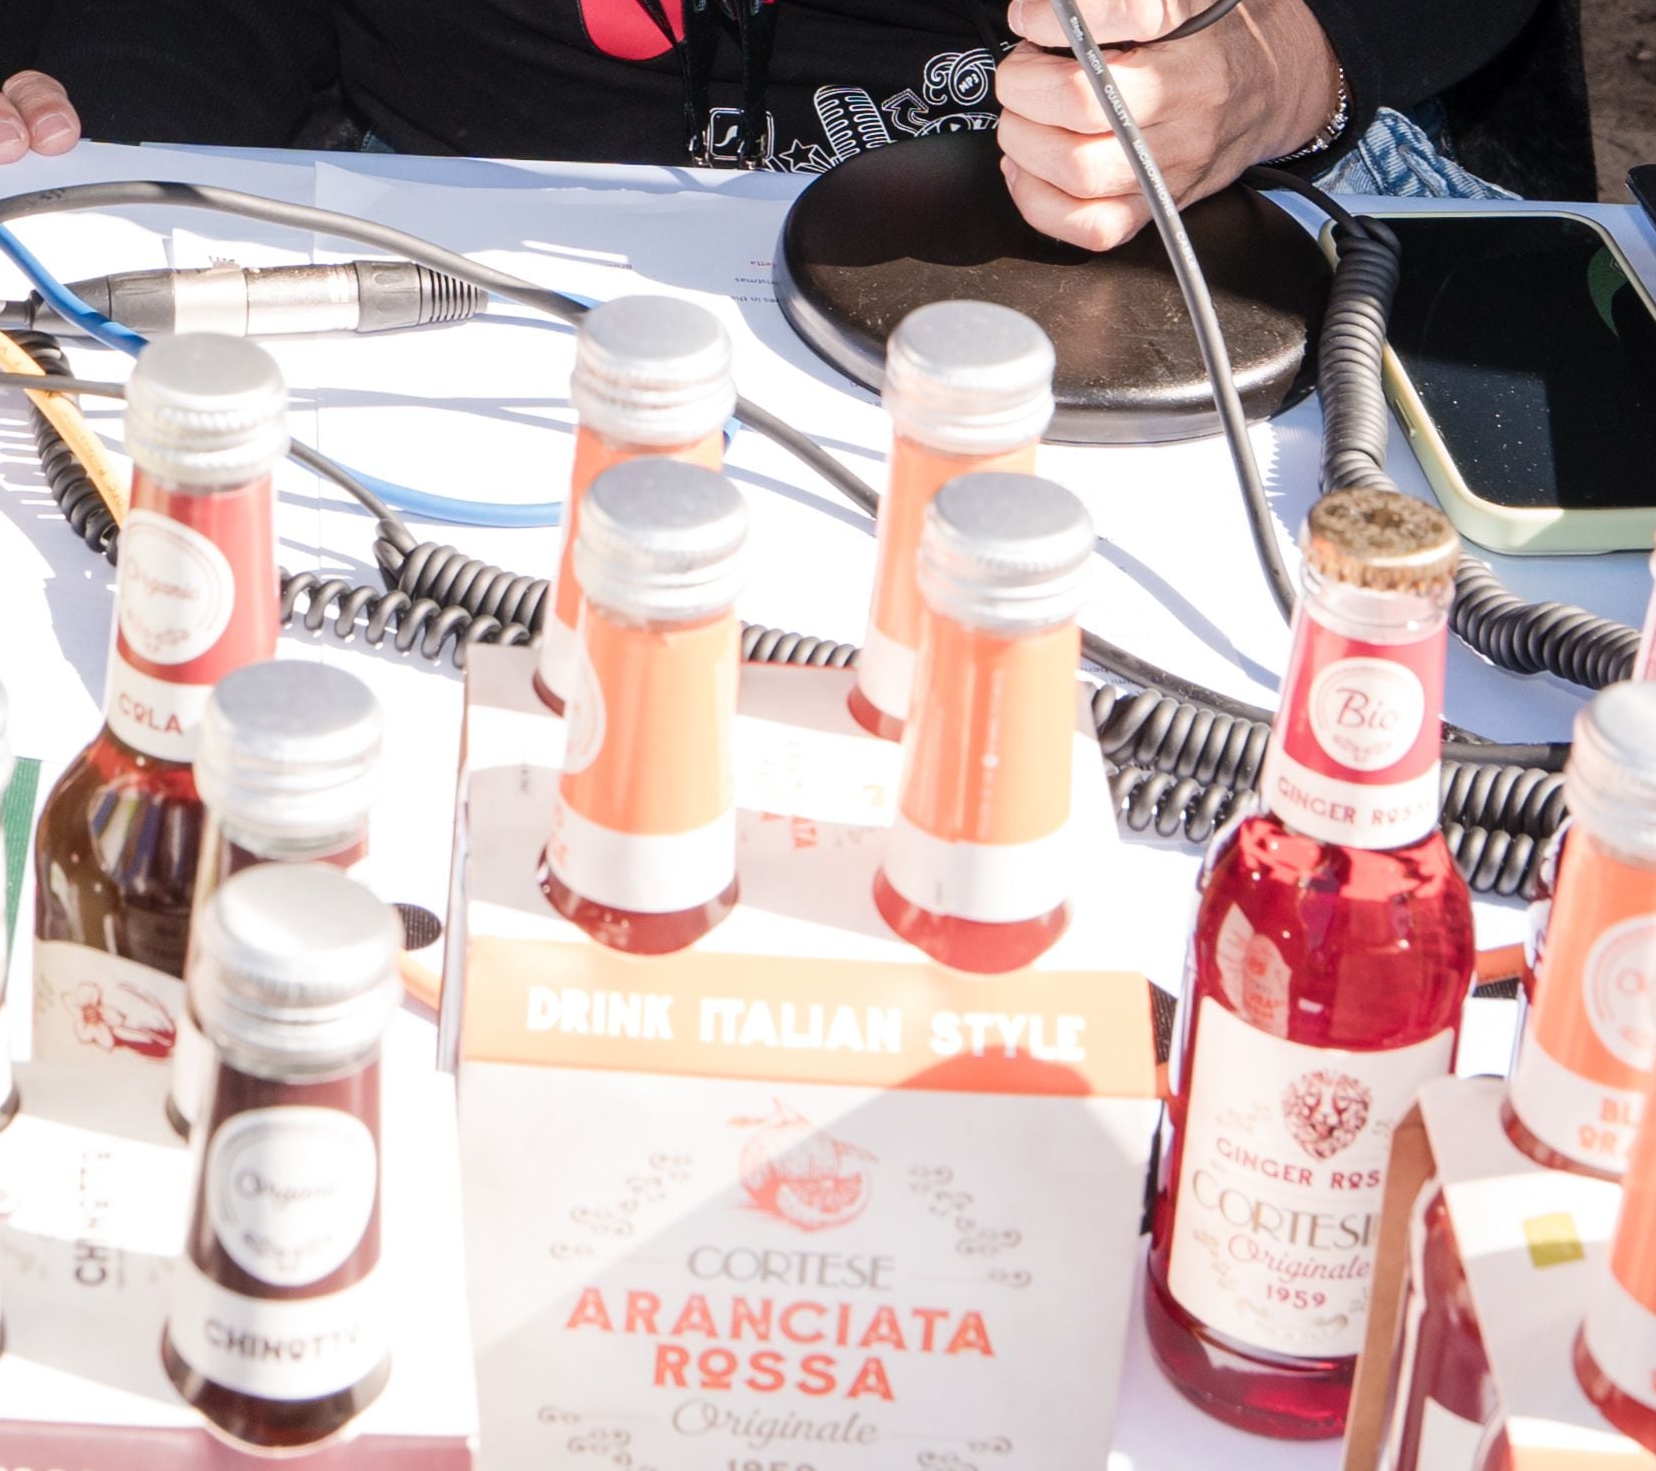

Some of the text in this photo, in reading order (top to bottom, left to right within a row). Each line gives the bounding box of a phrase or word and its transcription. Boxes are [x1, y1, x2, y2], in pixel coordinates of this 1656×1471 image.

[955, 70, 982, 95] MP3
[1086, 48, 1106, 76] HIGH
[1102, 83, 1132, 129] QUALITY
[1130, 137, 1173, 216] MICROPHONE
[117, 690, 186, 738] COLA
[1334, 686, 1402, 732] Bio
[1277, 772, 1364, 824] GINGER
[525, 984, 1088, 1063] DRINK ITALIAN STYLE
[1215, 1136, 1382, 1192] GINGER ROS
[1189, 1163, 1382, 1251] CORTES
[686, 1244, 897, 1293] CORTESE
[1225, 1232, 1373, 1285] Originale
[564, 1284, 997, 1358] ARANCIATA
[1263, 1280, 1329, 1313] 1959
[651, 1344, 898, 1402] ROSSA
[670, 1399, 879, 1451] Originale
